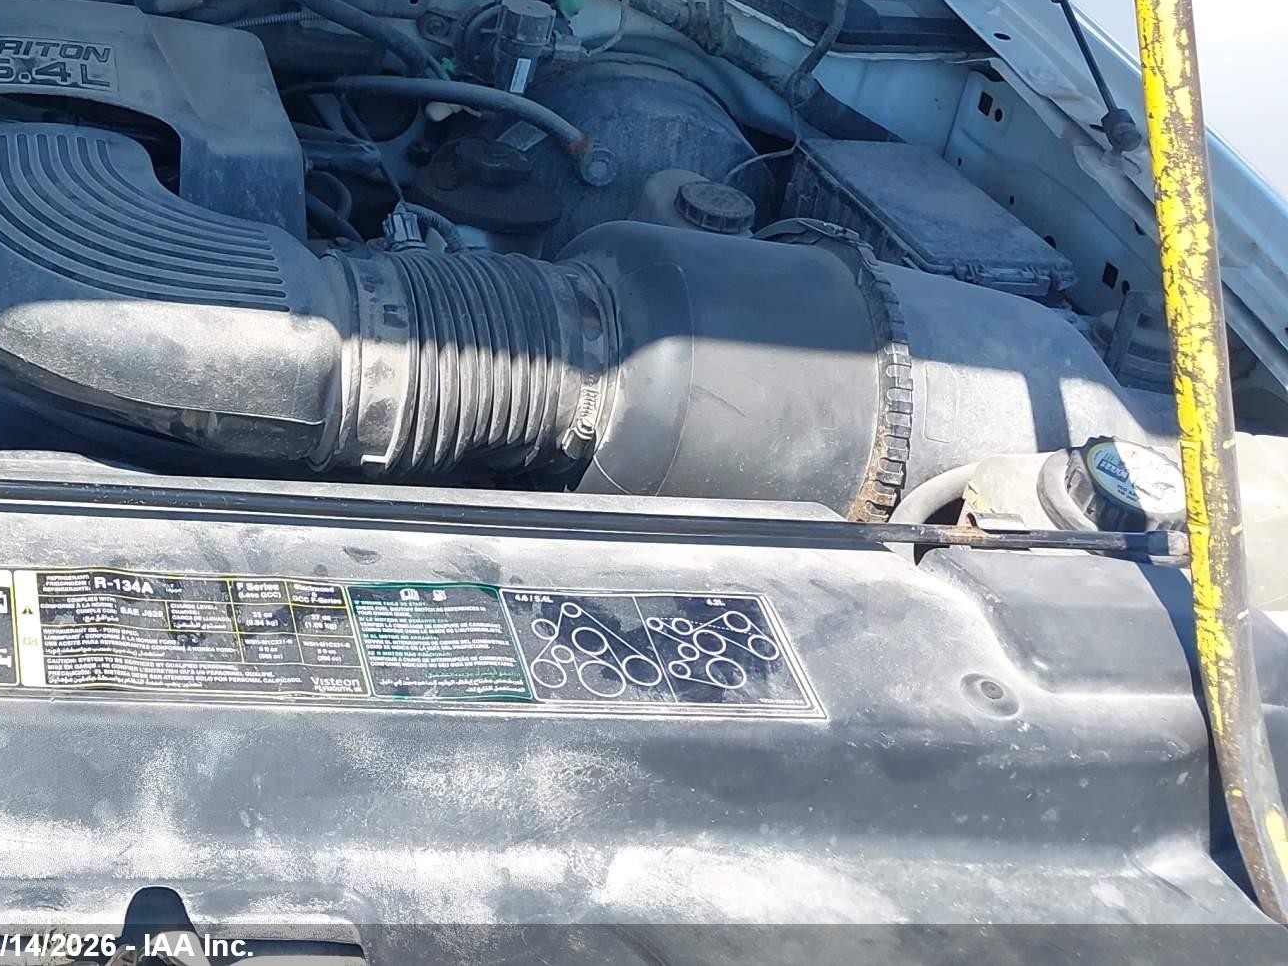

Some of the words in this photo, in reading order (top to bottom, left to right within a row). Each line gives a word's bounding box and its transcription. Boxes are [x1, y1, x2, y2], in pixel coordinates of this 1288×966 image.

[94, 576, 154, 594] R-134A
[515, 594, 529, 602] 4.6
[534, 595, 554, 604] 5.4L
[120, 606, 140, 616] SAE
[310, 676, 360, 686] Visteon
